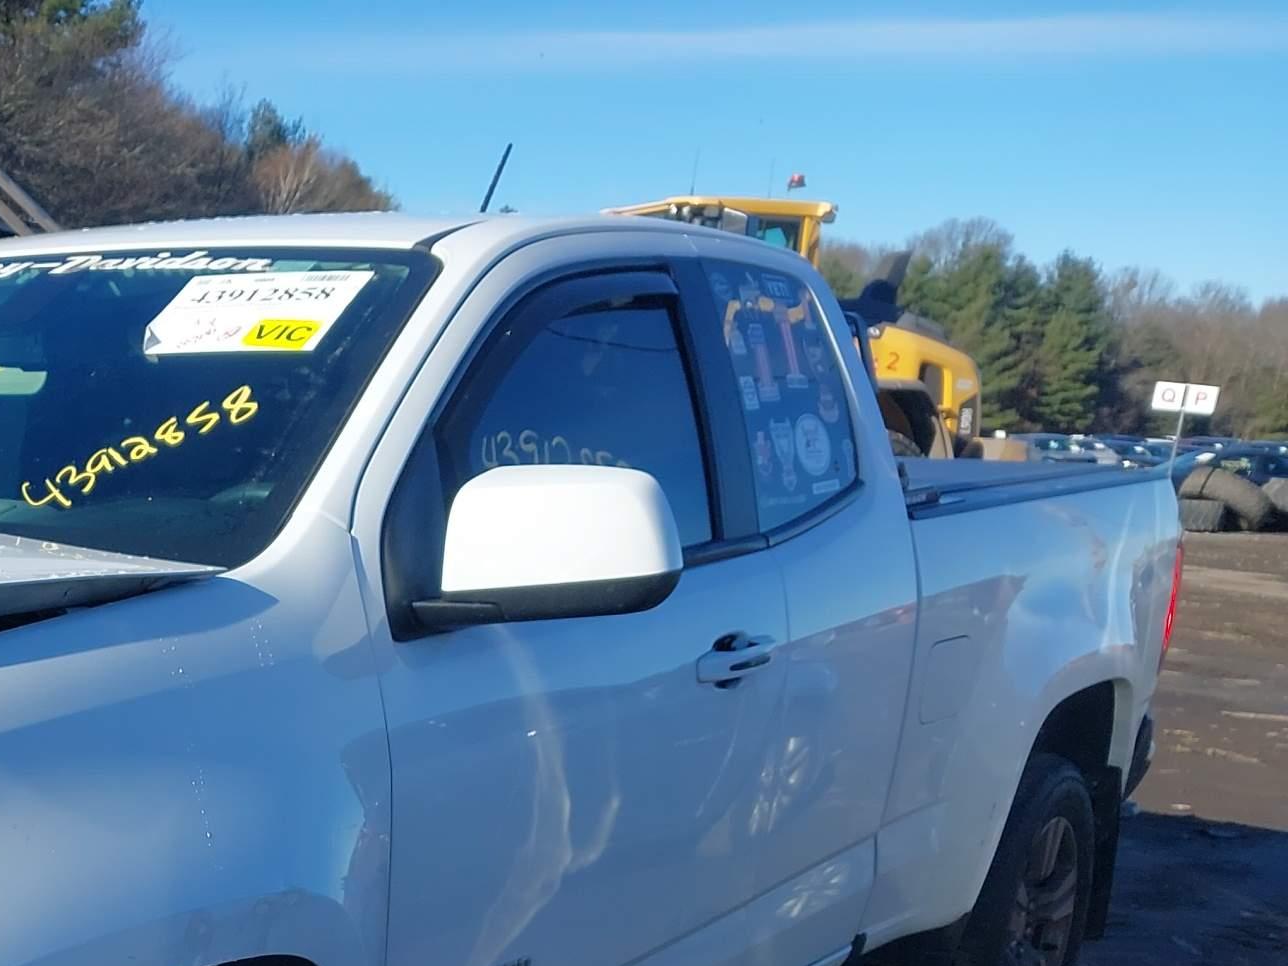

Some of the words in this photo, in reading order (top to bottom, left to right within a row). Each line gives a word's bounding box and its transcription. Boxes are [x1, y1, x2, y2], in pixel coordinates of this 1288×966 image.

[191, 286, 336, 304] 43912858
[255, 324, 313, 342] VIC
[887, 351, 901, 371] 2
[1161, 388, 1176, 402] Q
[1195, 391, 1207, 405] P
[21, 384, 259, 509] 43912858
